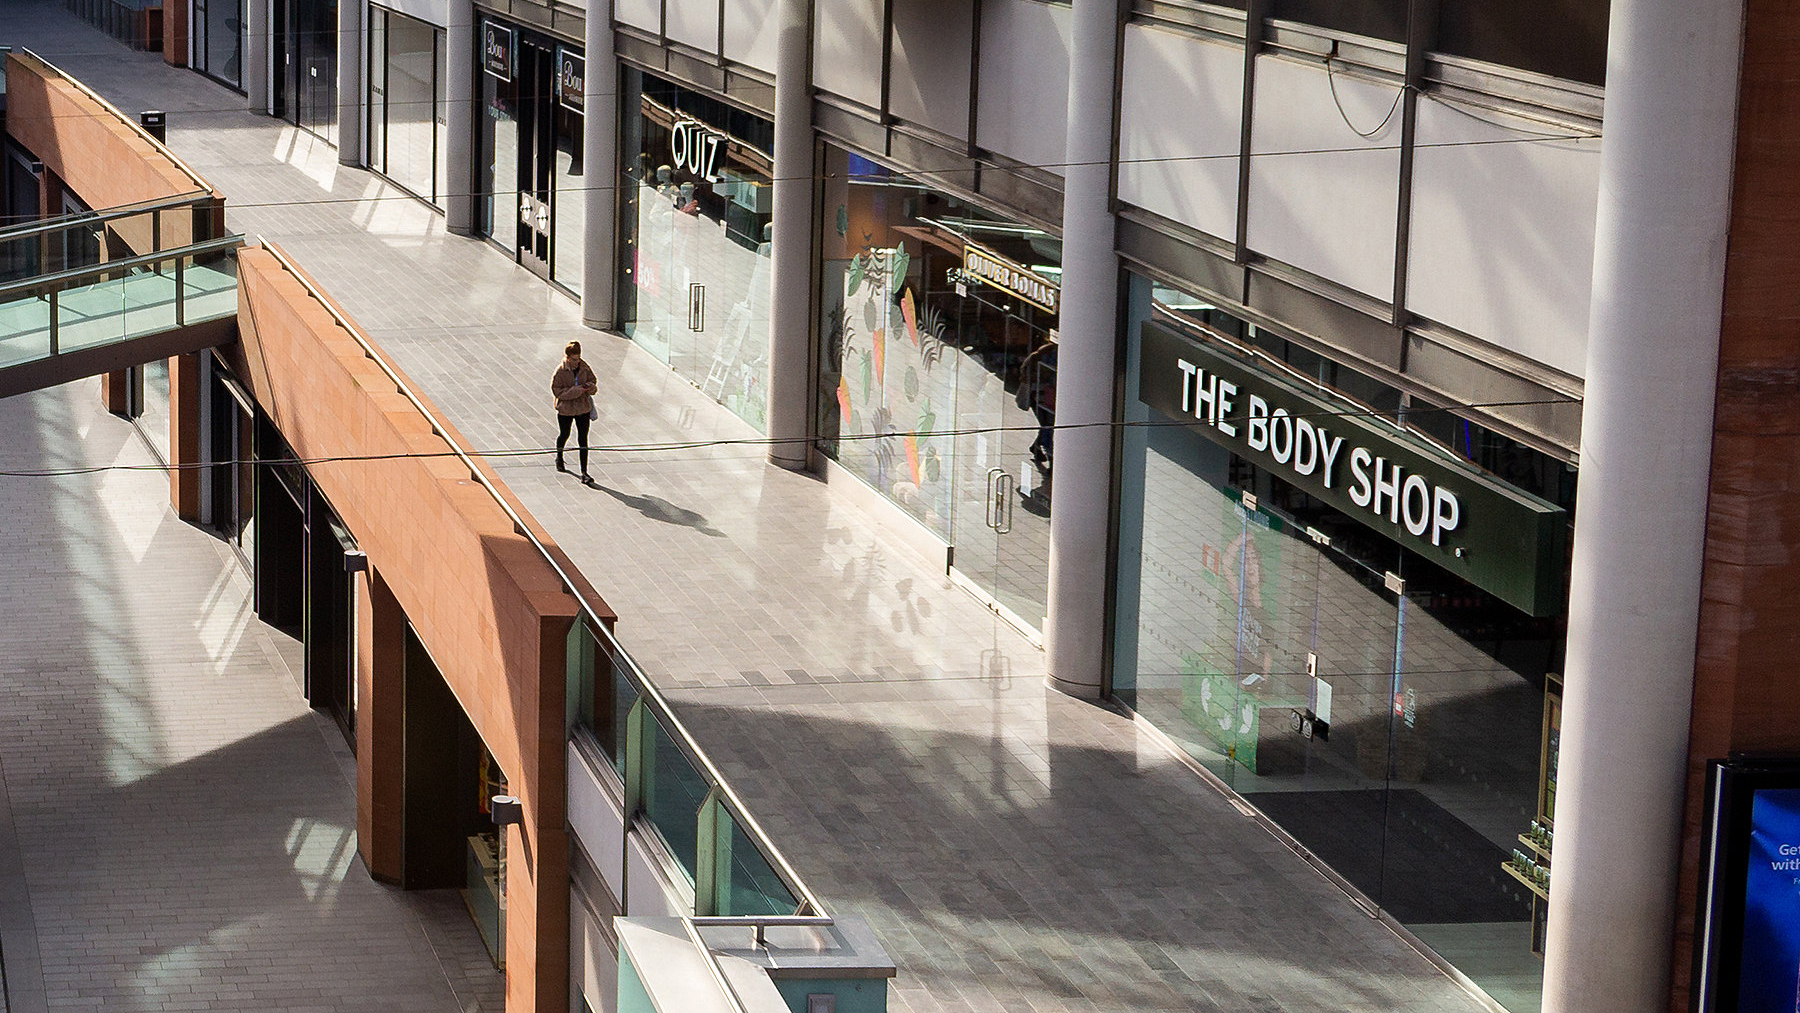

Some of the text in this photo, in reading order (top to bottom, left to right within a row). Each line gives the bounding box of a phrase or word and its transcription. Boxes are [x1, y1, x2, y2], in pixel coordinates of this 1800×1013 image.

[672, 121, 727, 183] QUIZ
[1177, 358, 1459, 546] THE BODY SHOP
